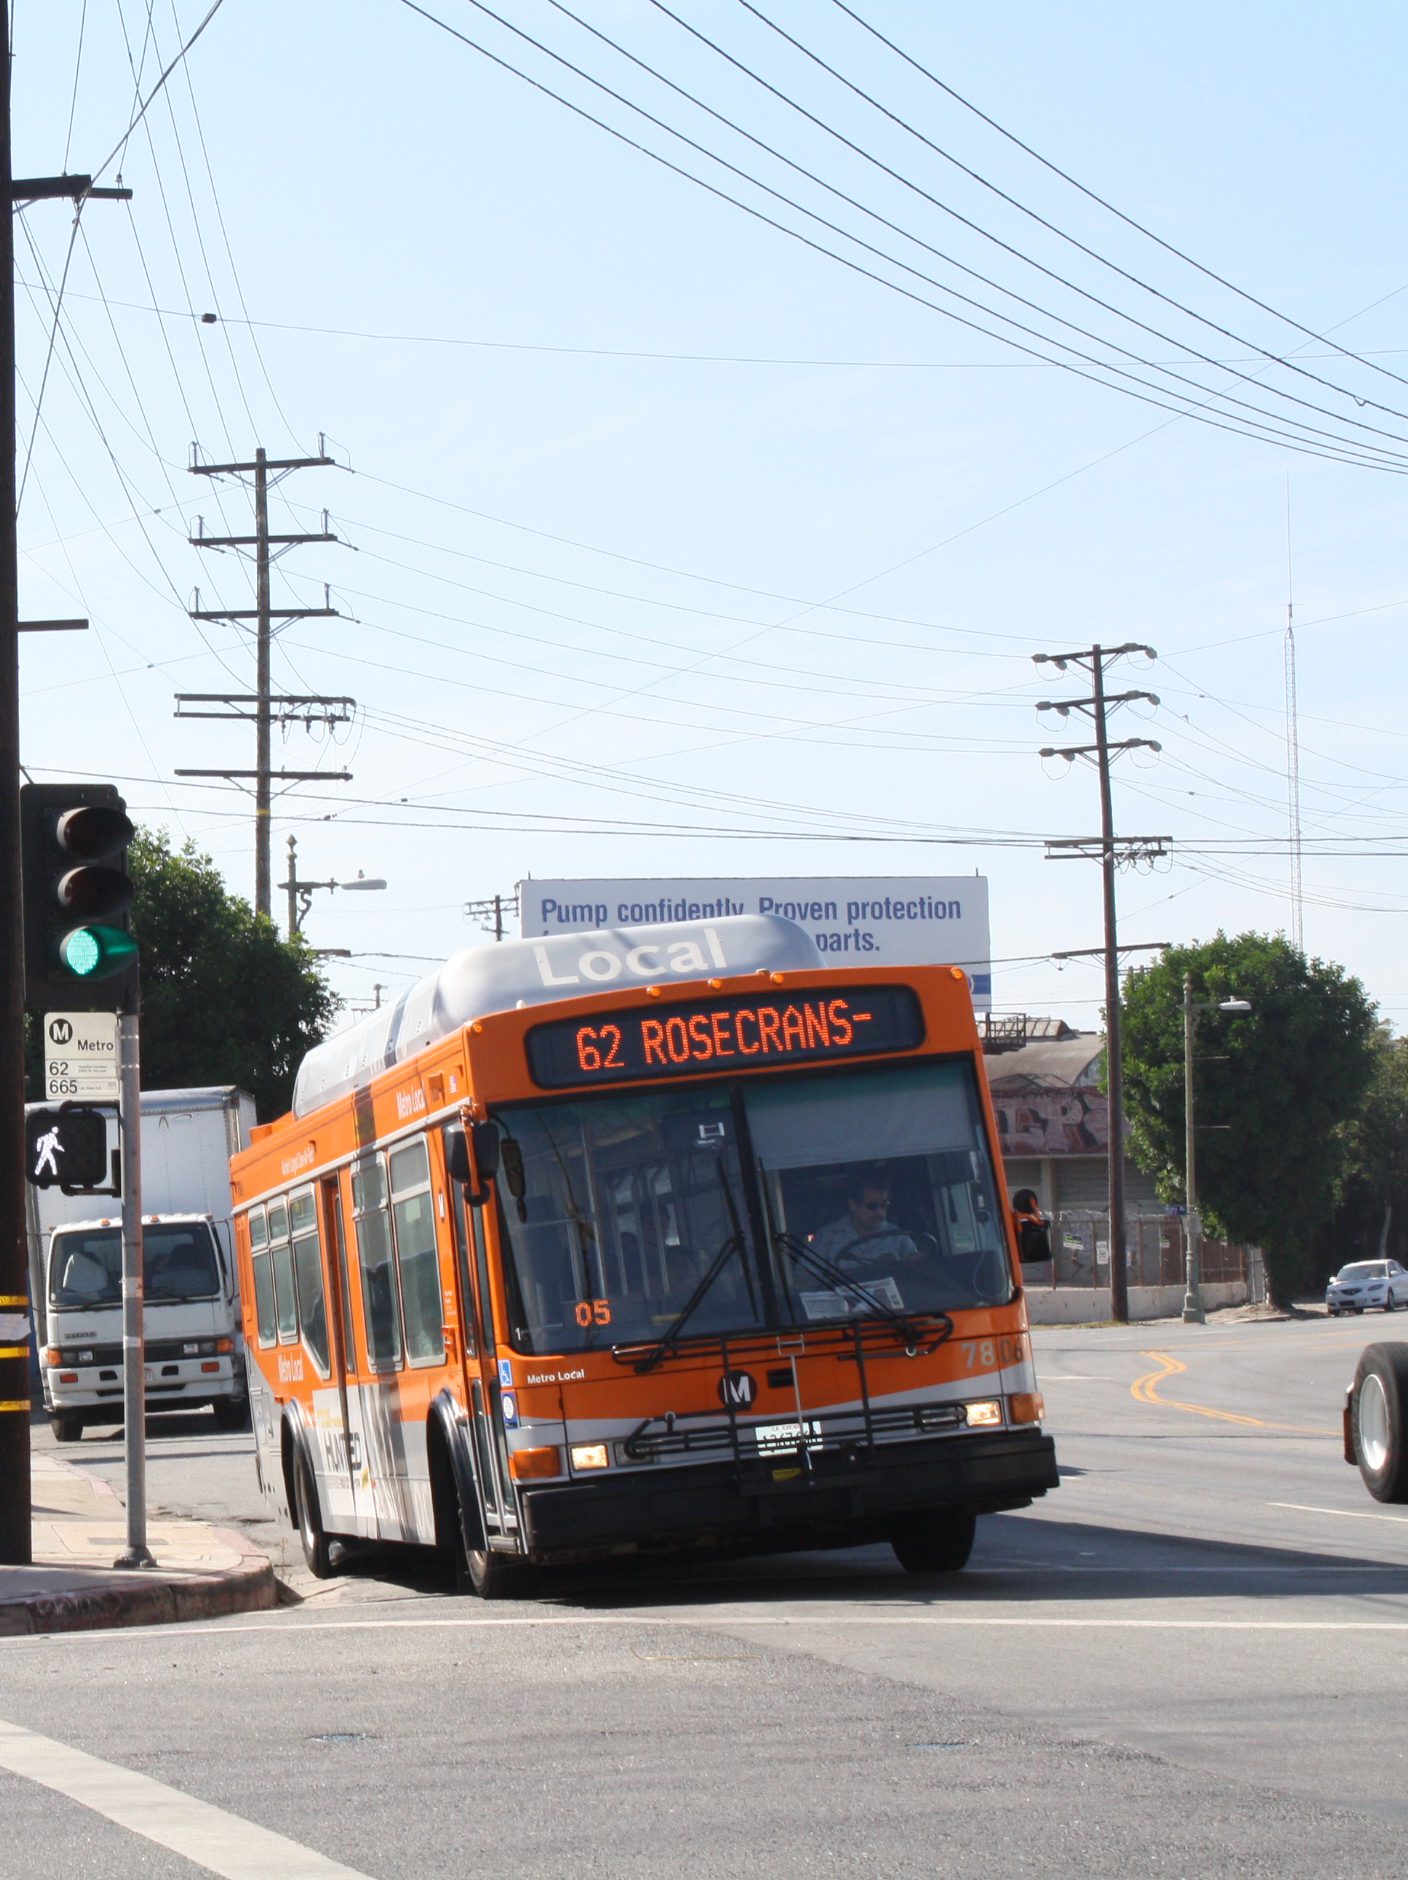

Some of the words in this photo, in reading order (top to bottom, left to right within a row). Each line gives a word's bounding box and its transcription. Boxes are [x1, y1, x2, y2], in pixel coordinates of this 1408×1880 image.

[541, 899, 608, 928] Pump
[617, 898, 744, 922] confidently
[758, 897, 838, 921] Proven
[847, 896, 961, 925] protection
[816, 928, 880, 952] parts.
[532, 928, 727, 987] Local
[77, 1039, 114, 1051] Metro
[575, 1024, 625, 1072] 62
[641, 998, 872, 1066] ROSECRANS-
[49, 1062, 69, 1076] 62
[49, 1080, 78, 1094] 665
[575, 1299, 611, 1327] 05
[527, 1372, 555, 1384] Metro
[558, 1368, 585, 1380] Local
